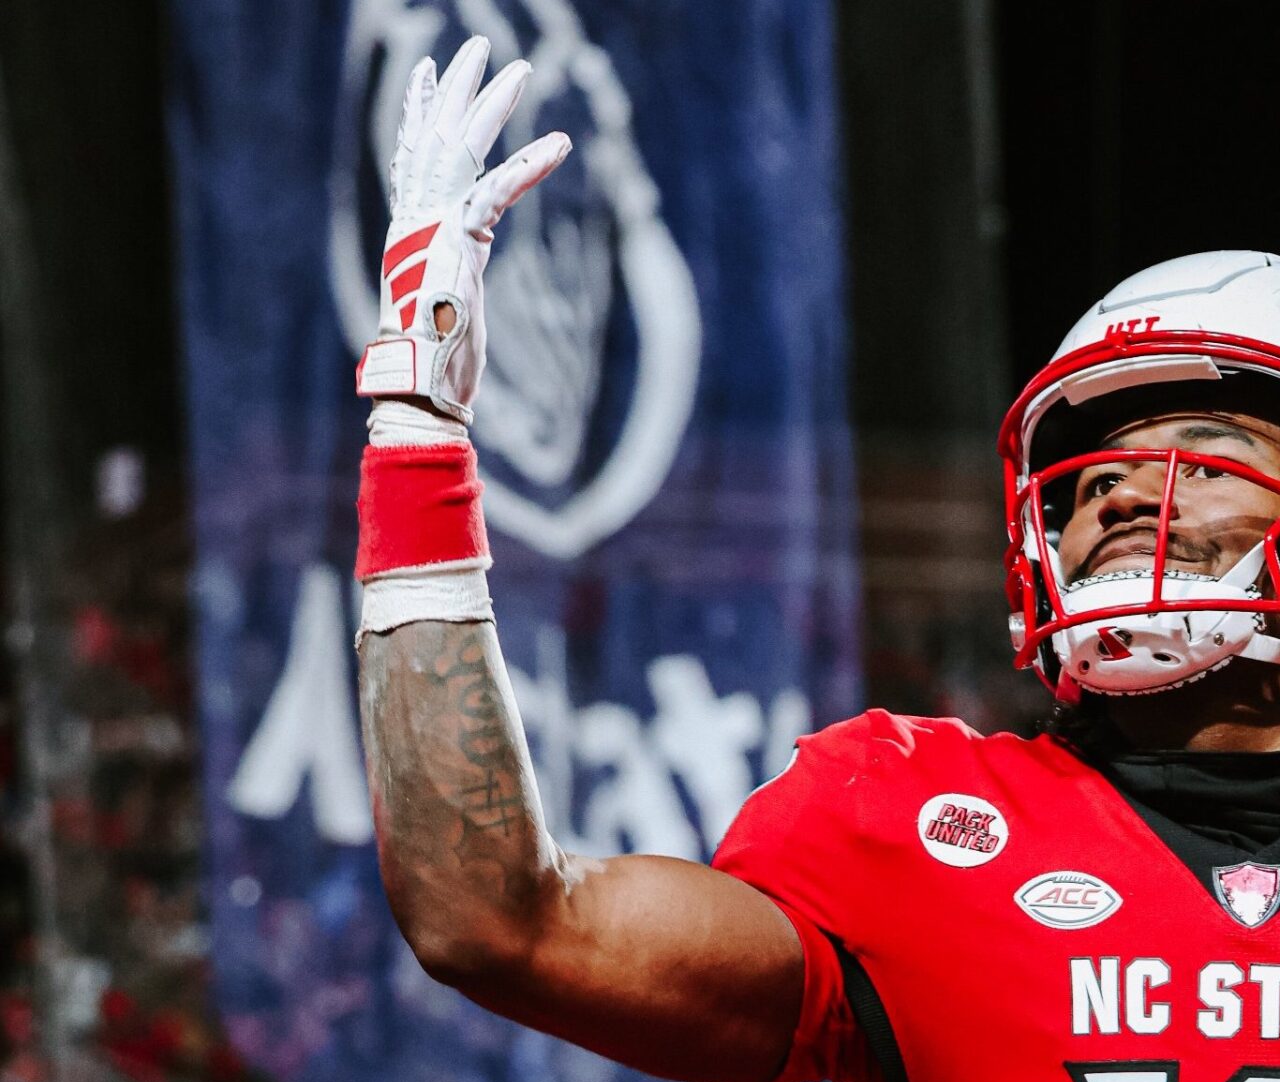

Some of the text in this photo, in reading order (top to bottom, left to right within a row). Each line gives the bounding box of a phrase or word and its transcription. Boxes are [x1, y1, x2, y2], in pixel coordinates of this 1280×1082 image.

[938, 803, 997, 832] PACK
[924, 819, 1000, 853] UNITED
[1037, 887, 1102, 905] ACC
[1069, 956, 1172, 1036] NC
